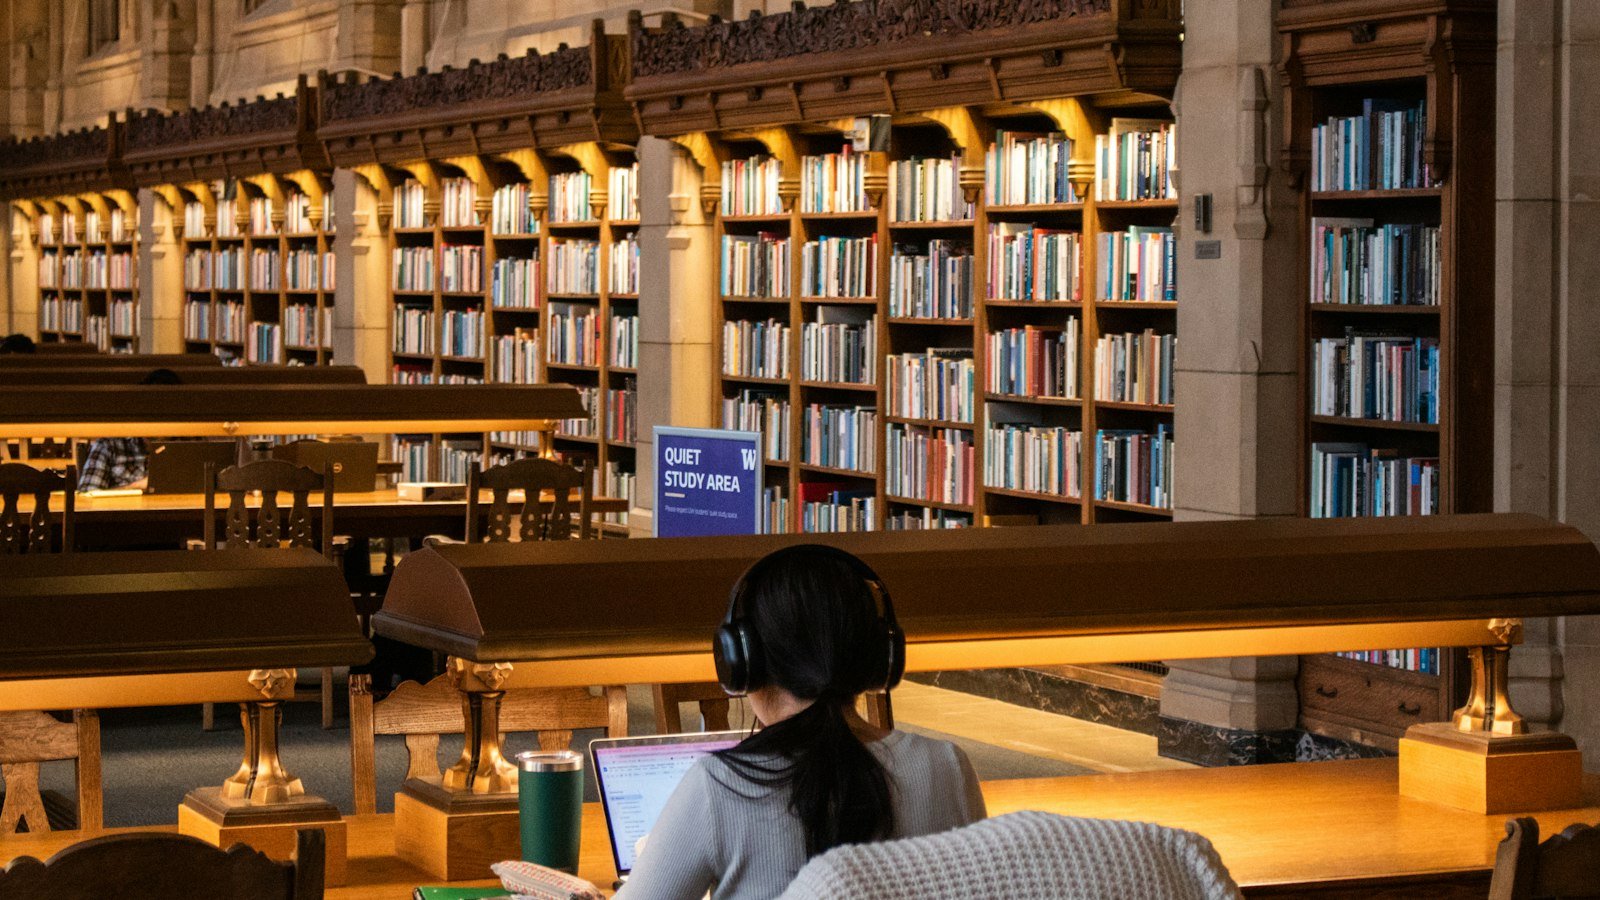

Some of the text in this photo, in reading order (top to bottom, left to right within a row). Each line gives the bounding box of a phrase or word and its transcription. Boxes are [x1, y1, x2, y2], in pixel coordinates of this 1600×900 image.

[665, 447, 701, 466] QUIET
[741, 448, 756, 471] W
[664, 470, 741, 493] STUDY AREA
